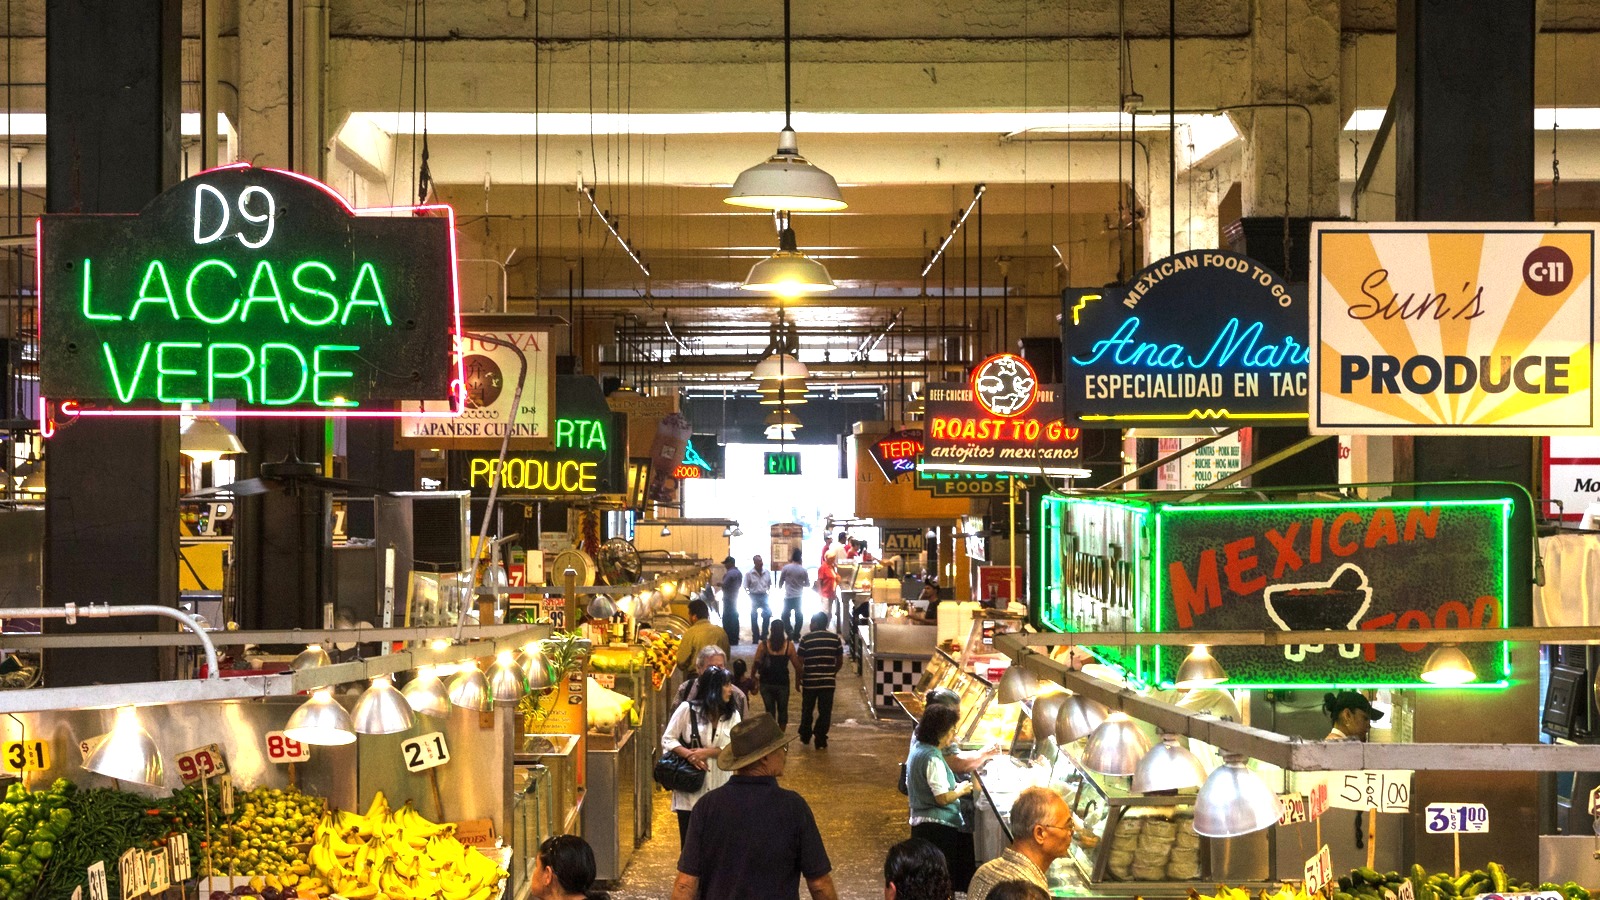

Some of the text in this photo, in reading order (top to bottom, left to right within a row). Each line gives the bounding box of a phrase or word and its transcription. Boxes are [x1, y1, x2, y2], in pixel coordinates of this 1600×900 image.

[193, 182, 275, 249] D9
[1123, 254, 1292, 309] MEXICAN FOOD TO GO
[1347, 268, 1485, 320] Sun's
[1072, 316, 1185, 369] Ana
[102, 341, 361, 407] VERDE
[1085, 373, 1223, 399] ESPECIALIDAD
[1234, 372, 1259, 397] EN
[1340, 354, 1570, 395] PRODUCE
[521, 406, 536, 415] D-8
[413, 422, 481, 436] JAPANESE
[931, 418, 1006, 440] ROAST
[1012, 420, 1040, 441] TO
[470, 457, 598, 492] PRODUCE
[768, 453, 797, 475] EXIT
[945, 481, 1006, 493] FOODS
[886, 533, 922, 549] ATM
[1169, 506, 1441, 629] MEXICAN
[9, 743, 26, 769] 3
[35, 742, 44, 769] 1
[268, 735, 302, 758] 89
[404, 742, 424, 768] 2
[178, 751, 214, 780] 99
[1340, 774, 1362, 803] 5
[1427, 807, 1450, 832] 3
